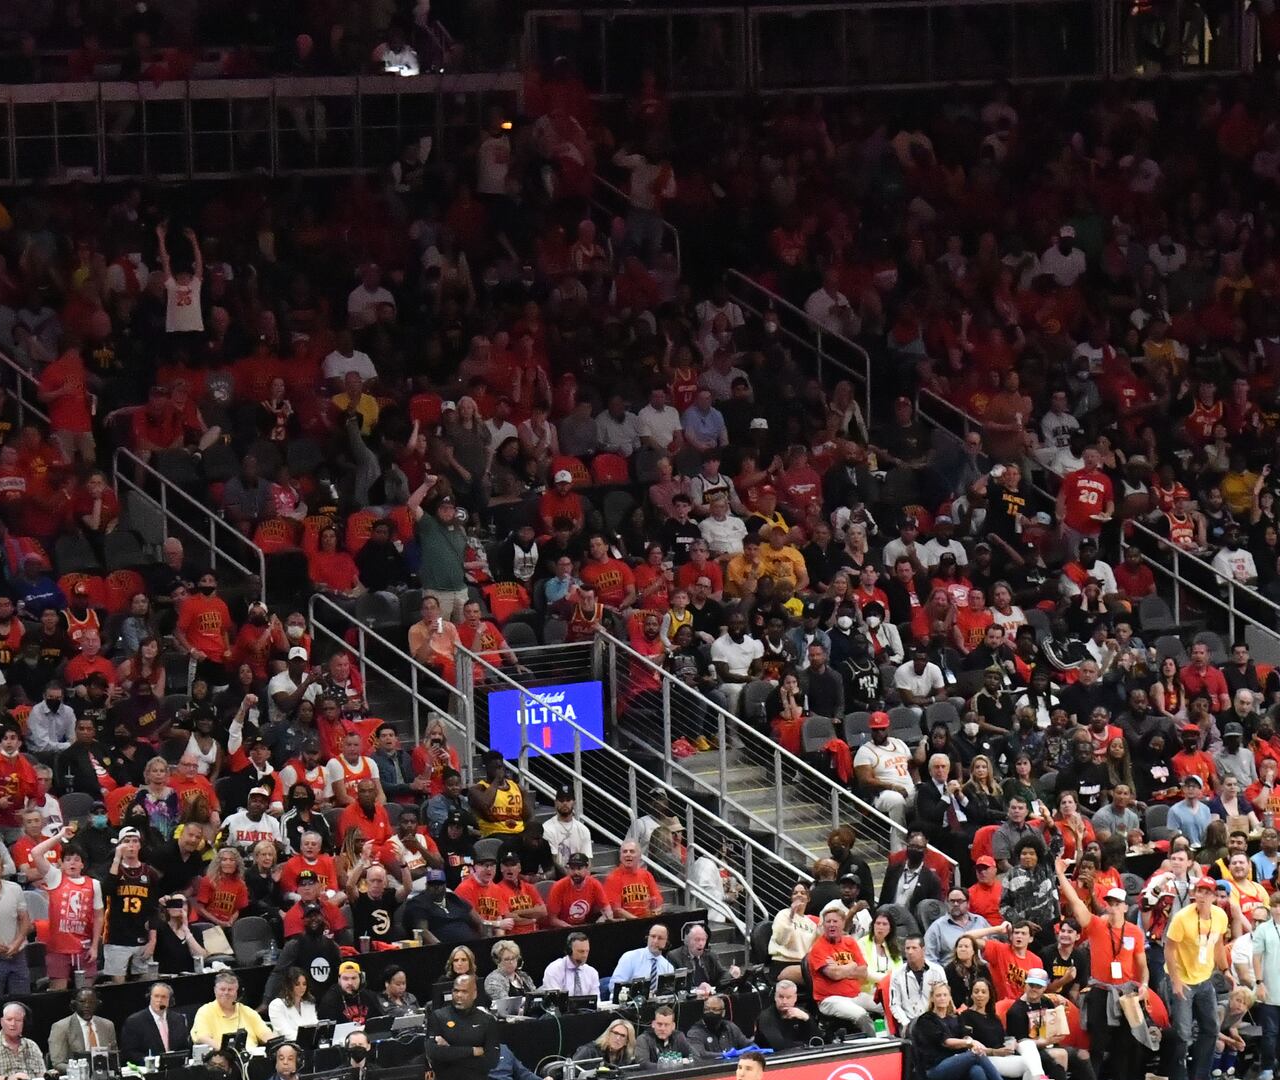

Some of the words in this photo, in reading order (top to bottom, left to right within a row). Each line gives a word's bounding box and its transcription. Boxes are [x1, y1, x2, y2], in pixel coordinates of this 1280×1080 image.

[1078, 490, 1099, 505] 20
[516, 703, 577, 726] ULTRA
[507, 794, 521, 806] 20
[235, 829, 274, 843] HAWKS
[117, 884, 149, 898] HAWKS
[122, 897, 142, 913] 13
[309, 965, 331, 976] TNT
